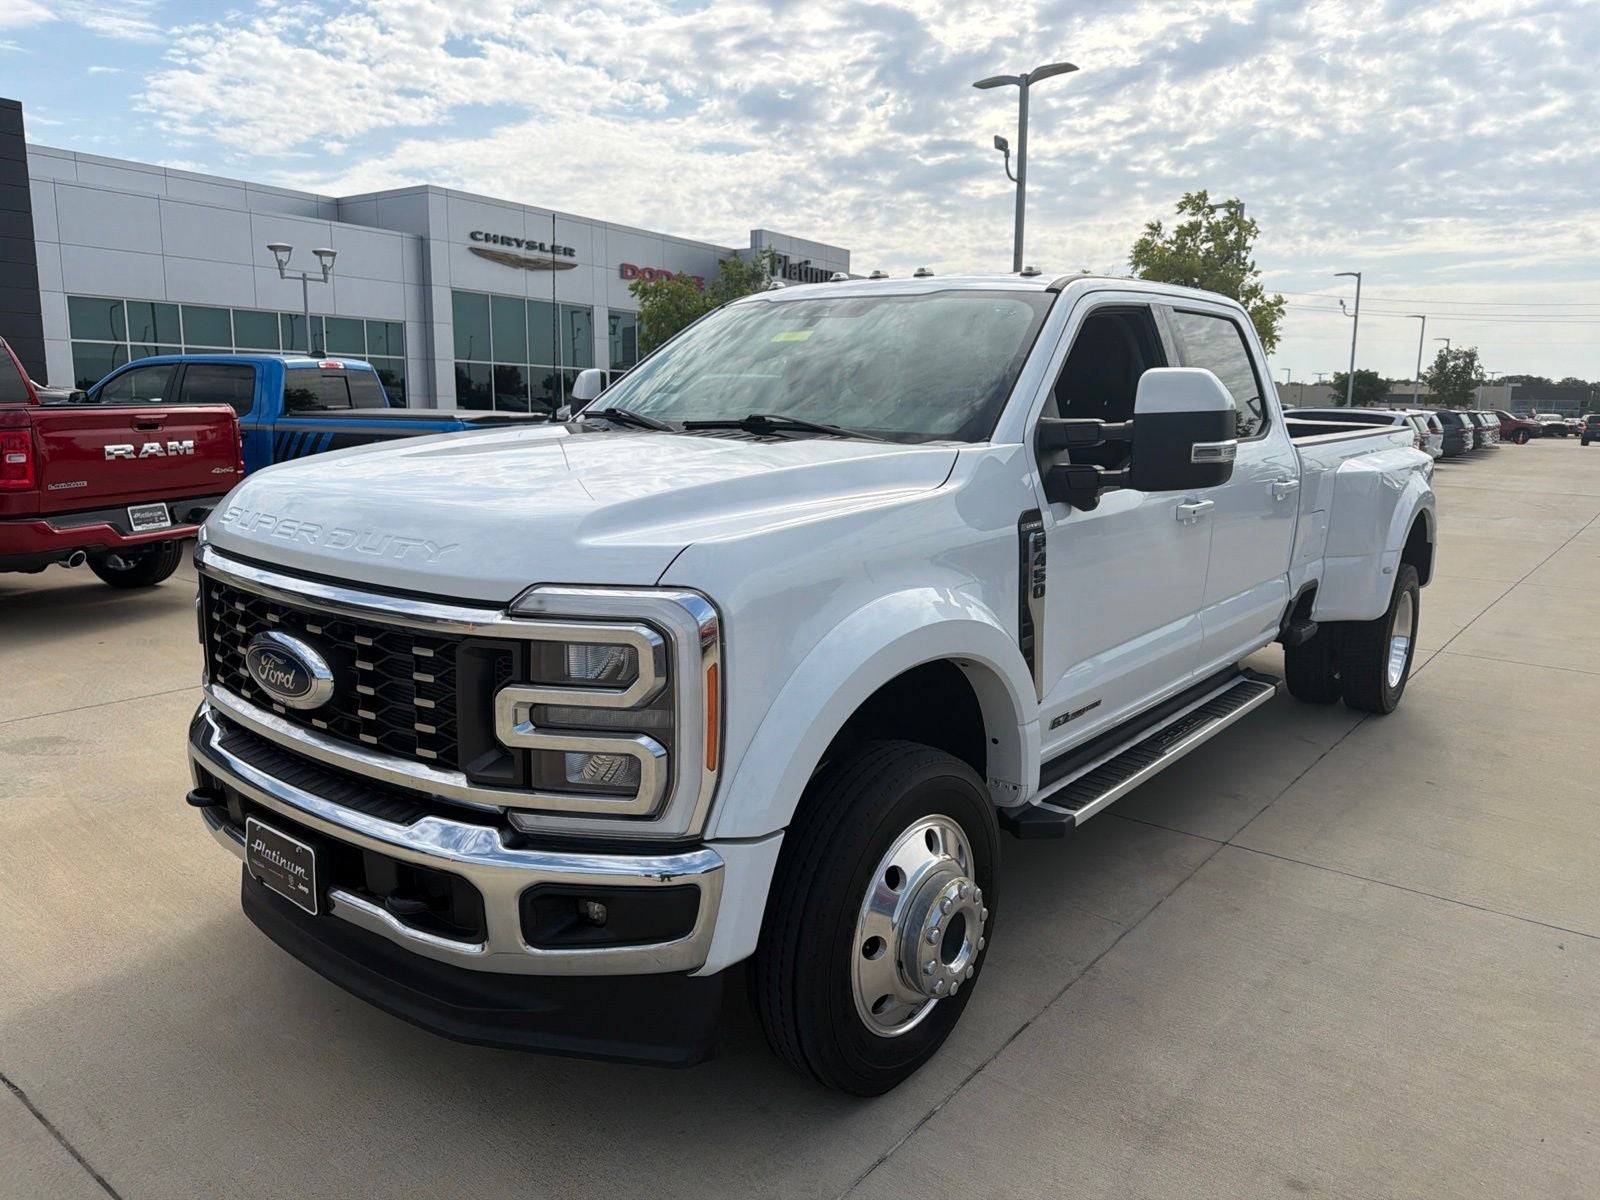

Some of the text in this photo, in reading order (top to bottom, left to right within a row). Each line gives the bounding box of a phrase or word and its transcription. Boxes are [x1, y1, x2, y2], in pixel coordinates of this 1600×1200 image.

[469, 230, 576, 257] CHRYSLER
[620, 263, 705, 293] DODE
[104, 440, 195, 461] RAM
[220, 506, 460, 563] SUPER DUTY
[258, 652, 296, 690] Ford
[251, 839, 309, 881] Platinum
